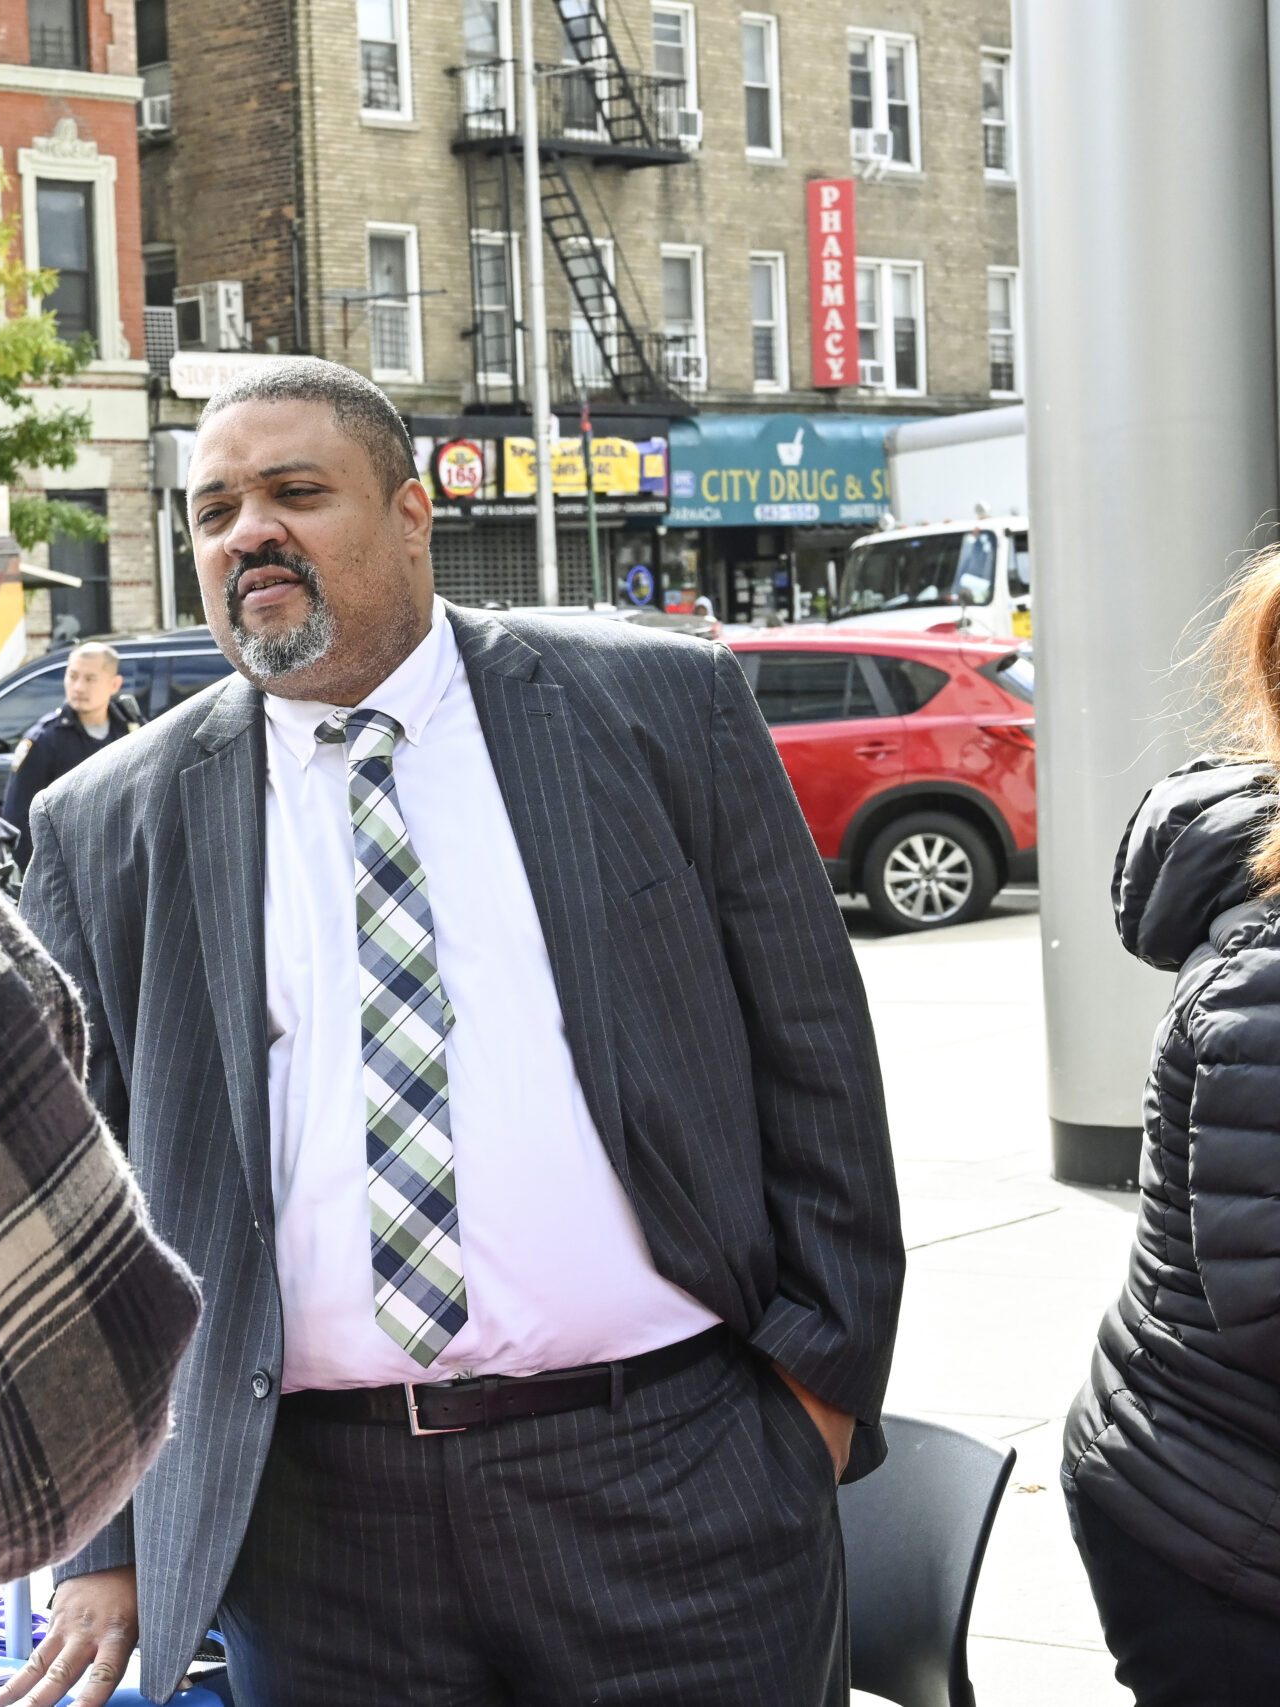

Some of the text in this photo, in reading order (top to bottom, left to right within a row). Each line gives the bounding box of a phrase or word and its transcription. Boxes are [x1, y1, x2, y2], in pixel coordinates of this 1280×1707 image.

[820, 185, 845, 381] PHARMACY
[447, 467, 477, 486] 165
[701, 468, 761, 503] CITY
[769, 468, 839, 501] DRUG
[845, 473, 865, 500] &
